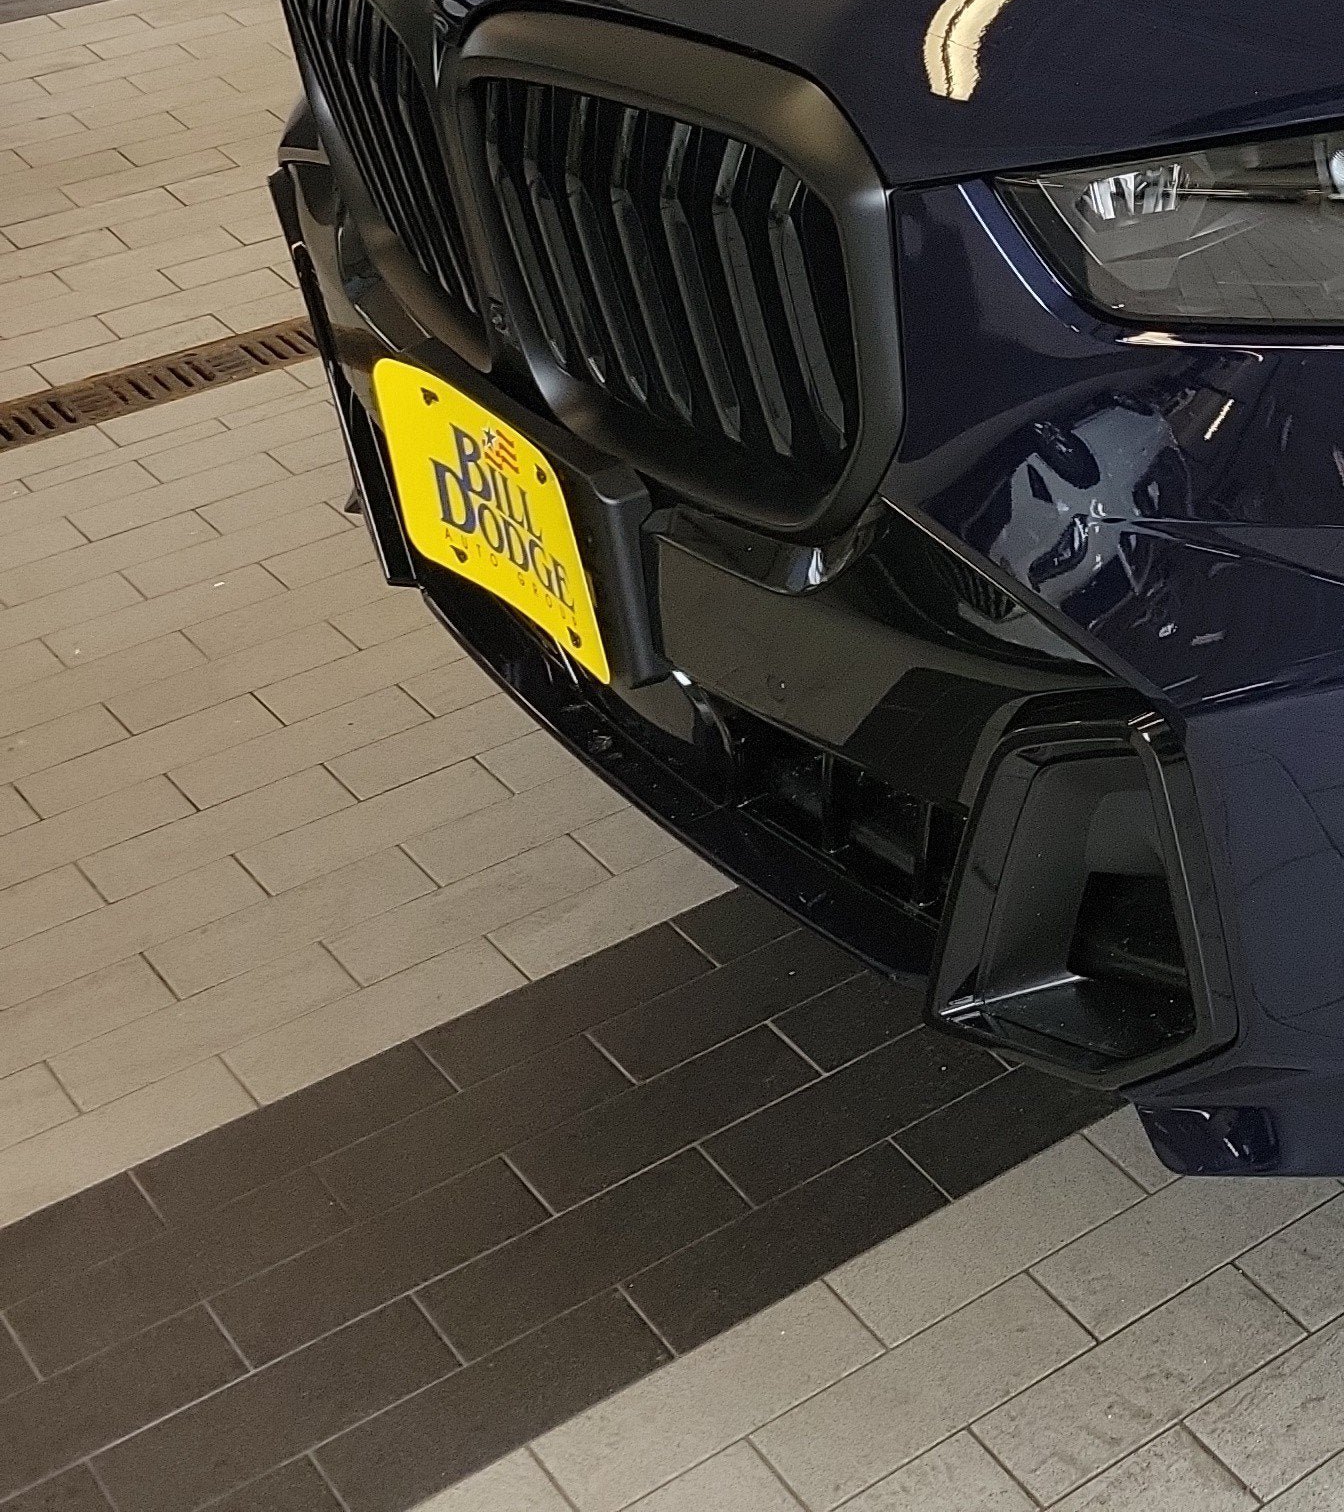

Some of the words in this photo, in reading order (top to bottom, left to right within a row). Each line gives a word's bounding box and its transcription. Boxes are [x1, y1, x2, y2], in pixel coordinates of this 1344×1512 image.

[429, 456, 576, 615] DODGE
[449, 422, 543, 544] BILL
[444, 527, 499, 568] AUTO
